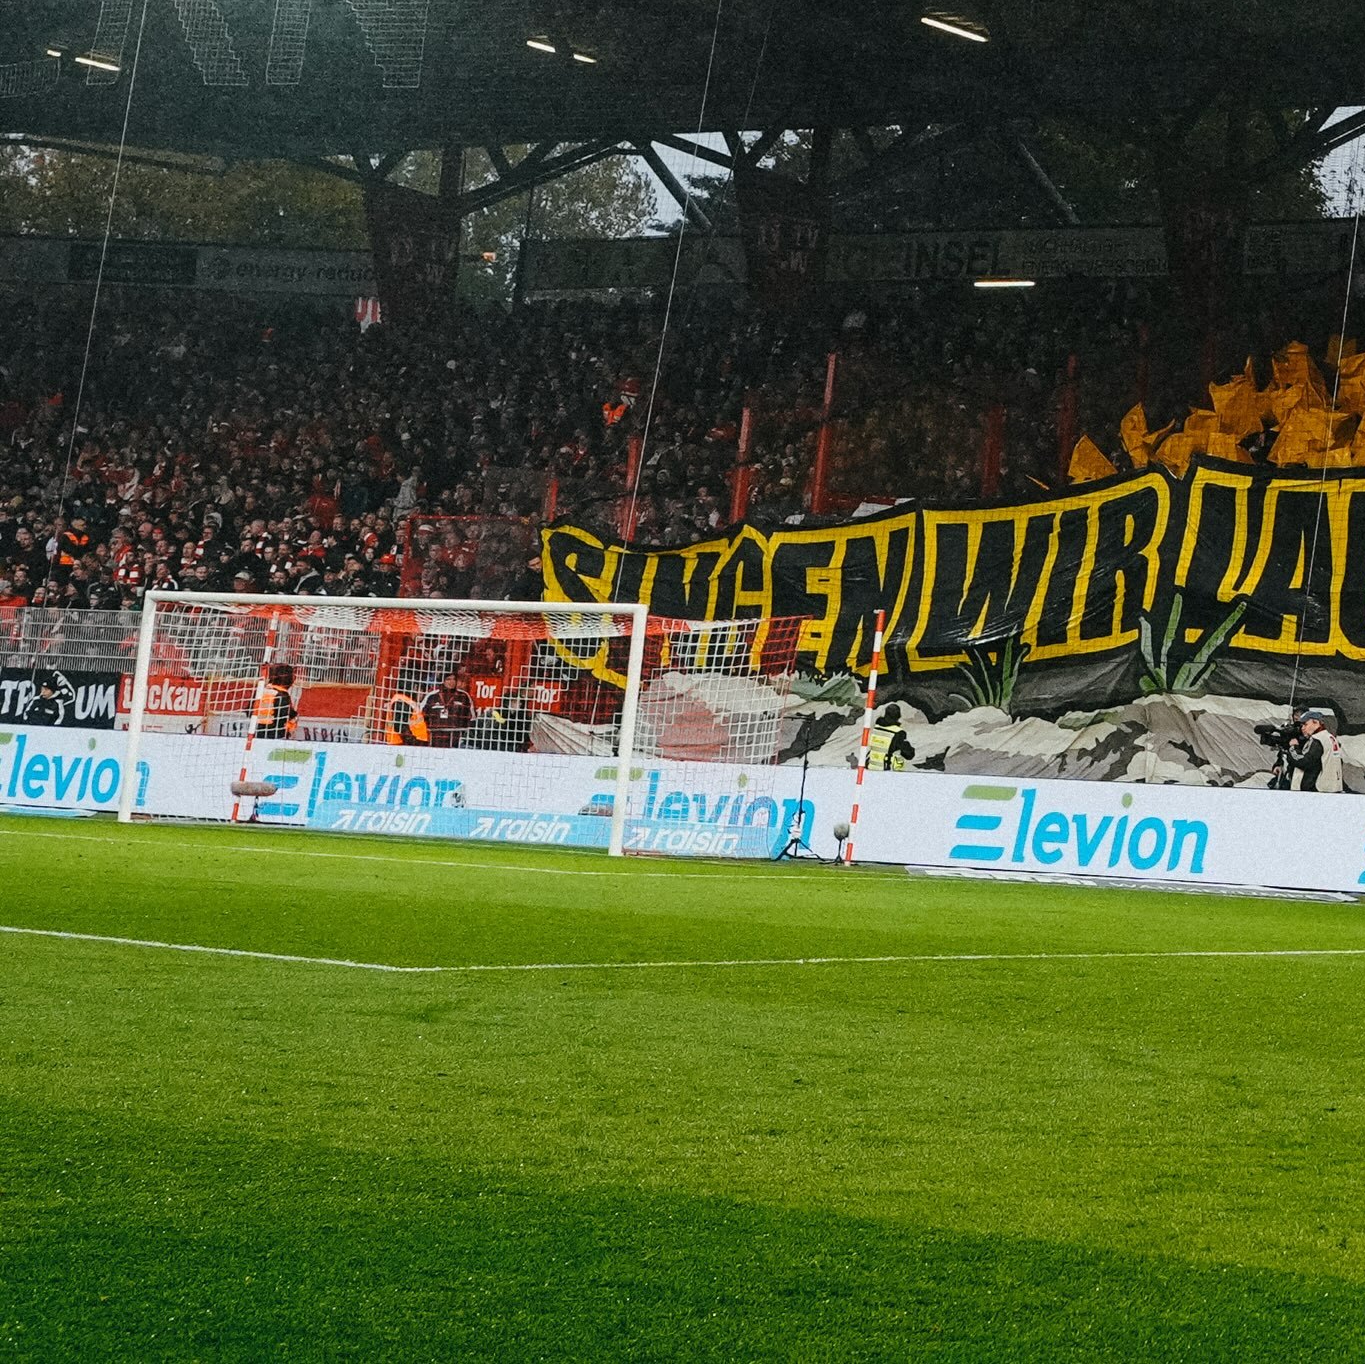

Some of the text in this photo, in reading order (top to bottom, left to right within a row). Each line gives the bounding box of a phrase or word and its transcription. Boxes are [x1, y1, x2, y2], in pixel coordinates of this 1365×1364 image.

[906, 472, 1169, 672] WIR
[121, 677, 202, 712] Lckau
[475, 681, 497, 698] Tor
[0, 733, 150, 807] levion
[491, 814, 573, 844] raisin
[949, 784, 1210, 874] Elevion
